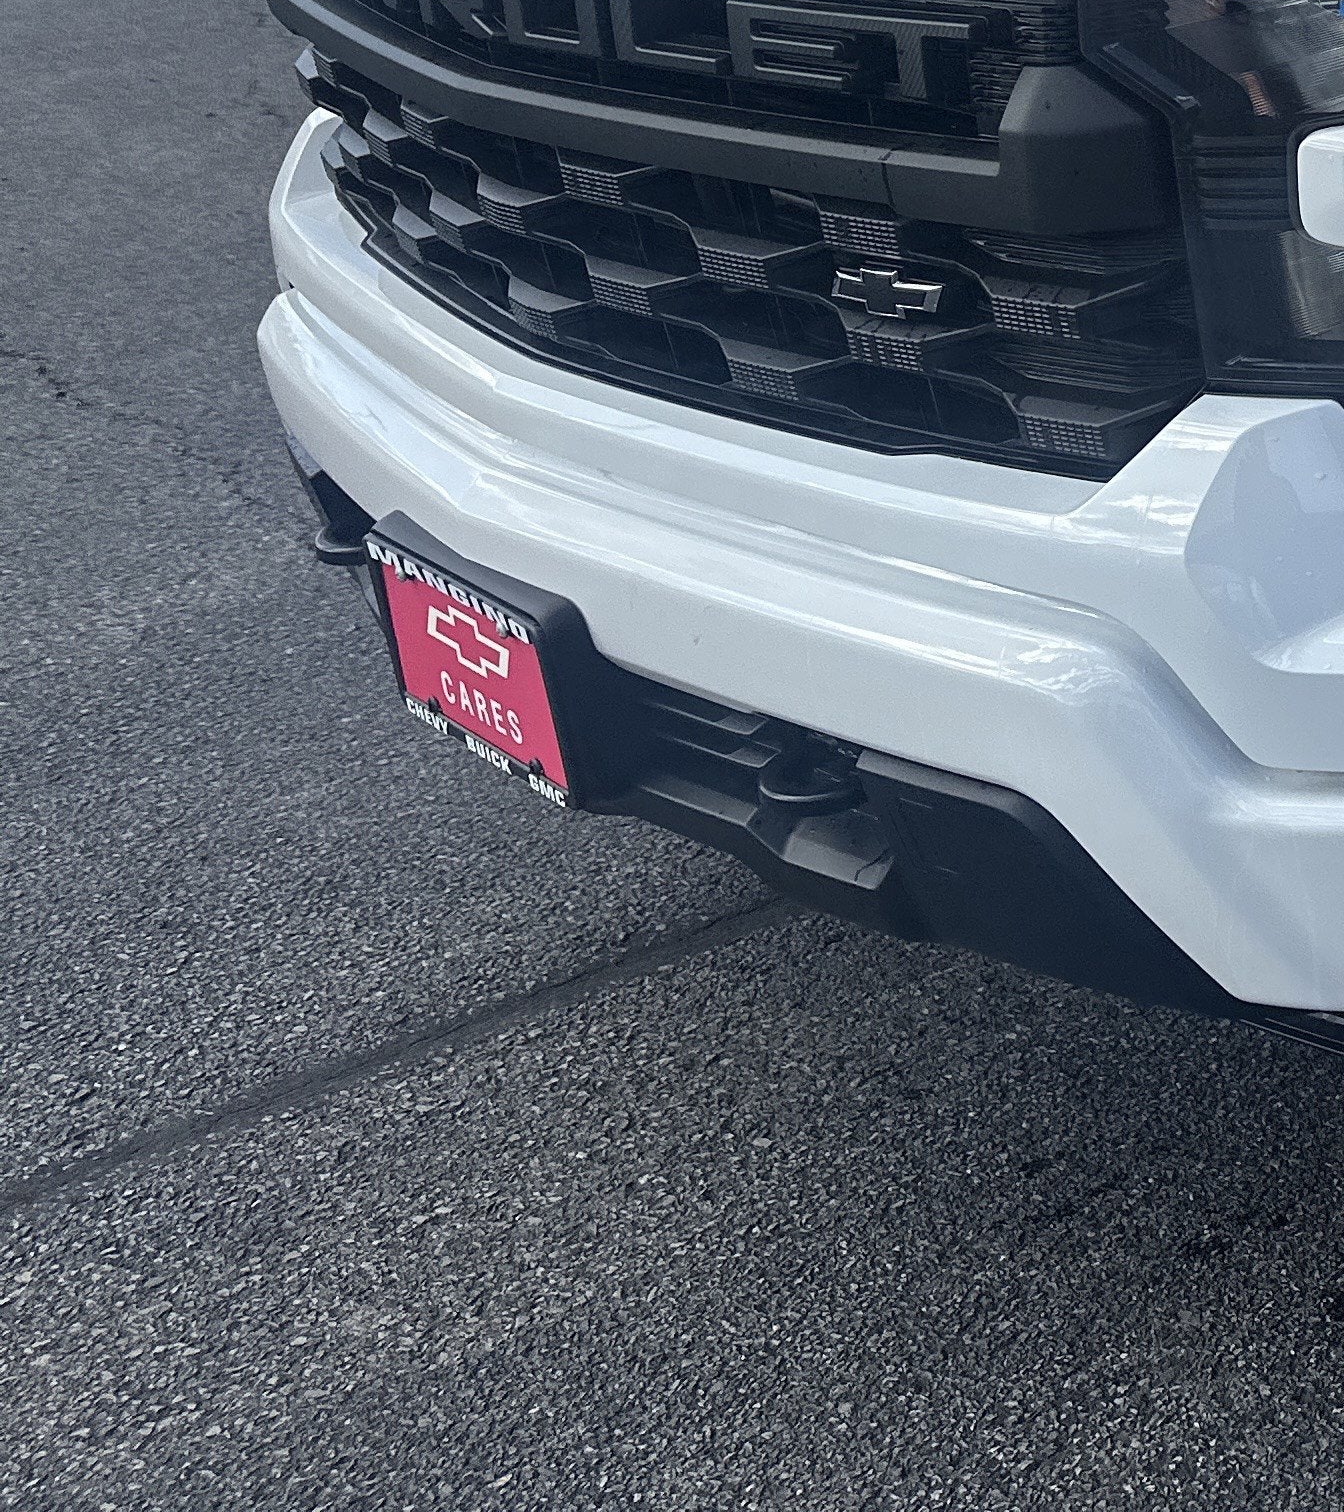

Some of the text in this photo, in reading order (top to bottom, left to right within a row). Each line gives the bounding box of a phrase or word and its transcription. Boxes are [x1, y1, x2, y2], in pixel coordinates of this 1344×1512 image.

[366, 541, 532, 645] MANGINO
[405, 697, 567, 808] CHEVY BUICK GMC
[440, 669, 524, 746] CARES
